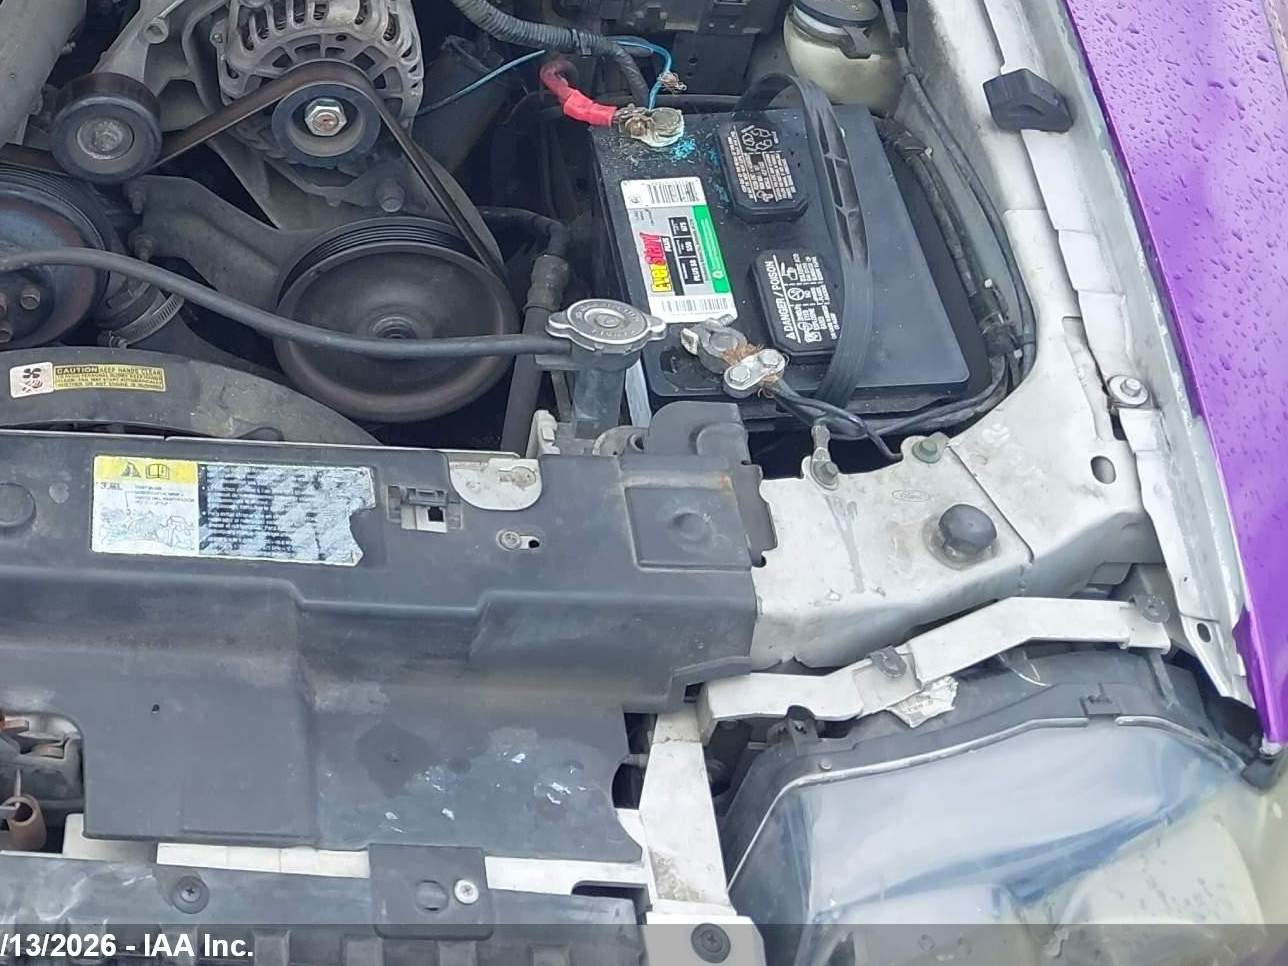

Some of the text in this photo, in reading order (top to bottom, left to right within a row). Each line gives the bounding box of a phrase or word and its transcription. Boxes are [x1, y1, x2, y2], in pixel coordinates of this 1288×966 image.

[661, 237, 672, 252] PLUS
[765, 260, 782, 291] POISON
[775, 298, 794, 332] DANGER
[56, 367, 99, 375] CAUTION
